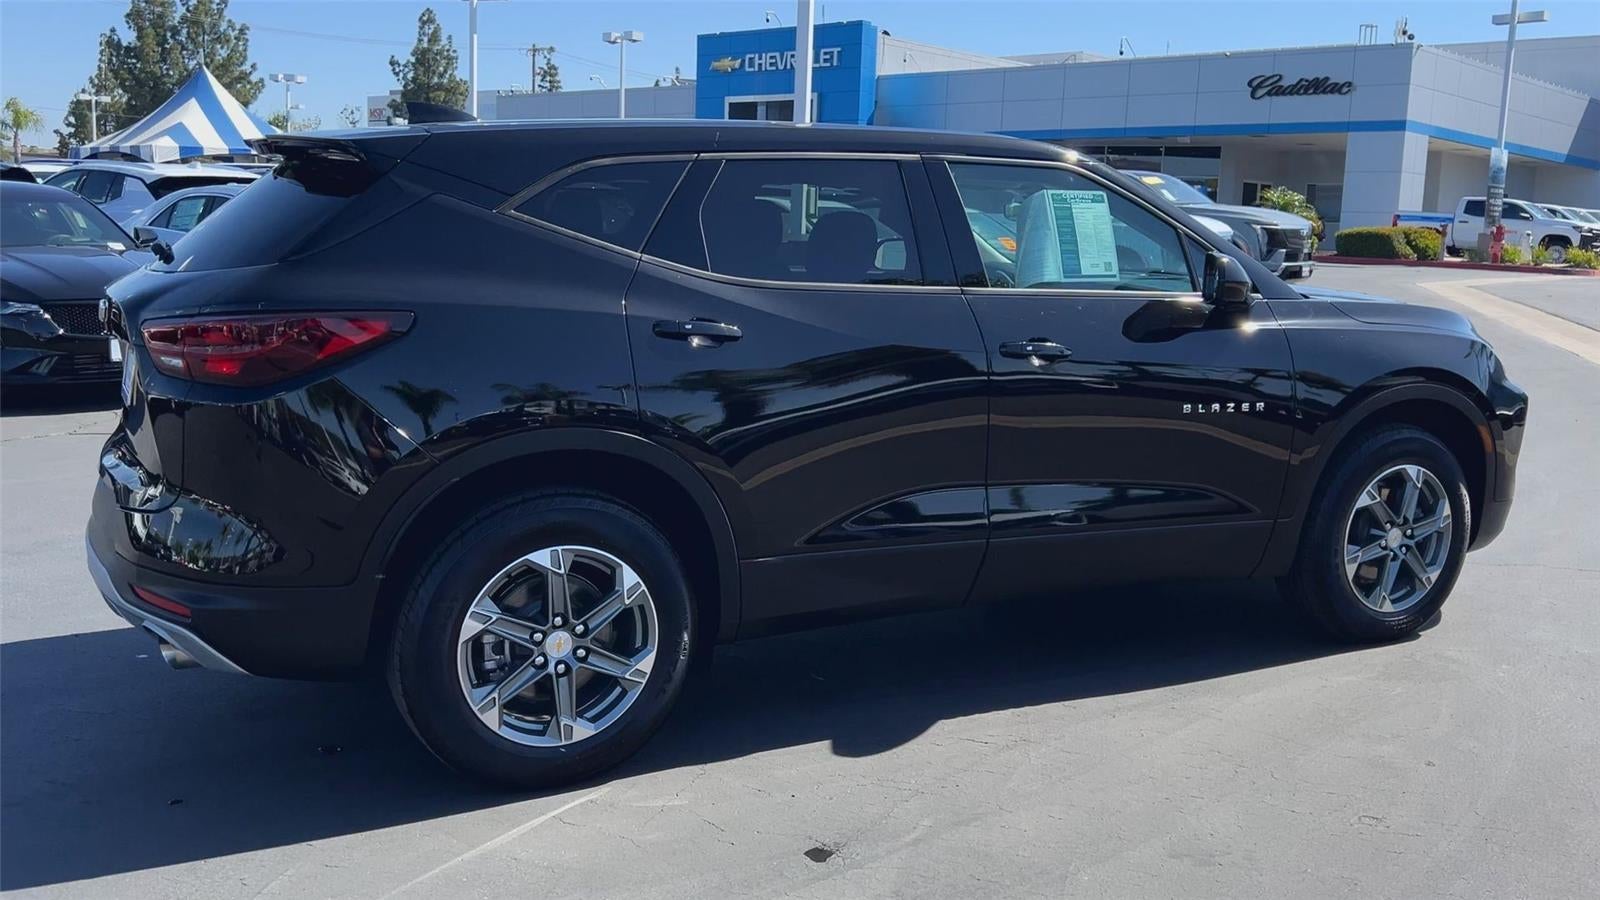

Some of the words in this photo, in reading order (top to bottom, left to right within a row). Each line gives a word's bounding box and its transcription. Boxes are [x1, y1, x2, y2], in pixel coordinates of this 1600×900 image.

[745, 47, 842, 72] CHEVRET
[1247, 73, 1353, 100] Cadillac
[1182, 402, 1265, 414] BLAZER
